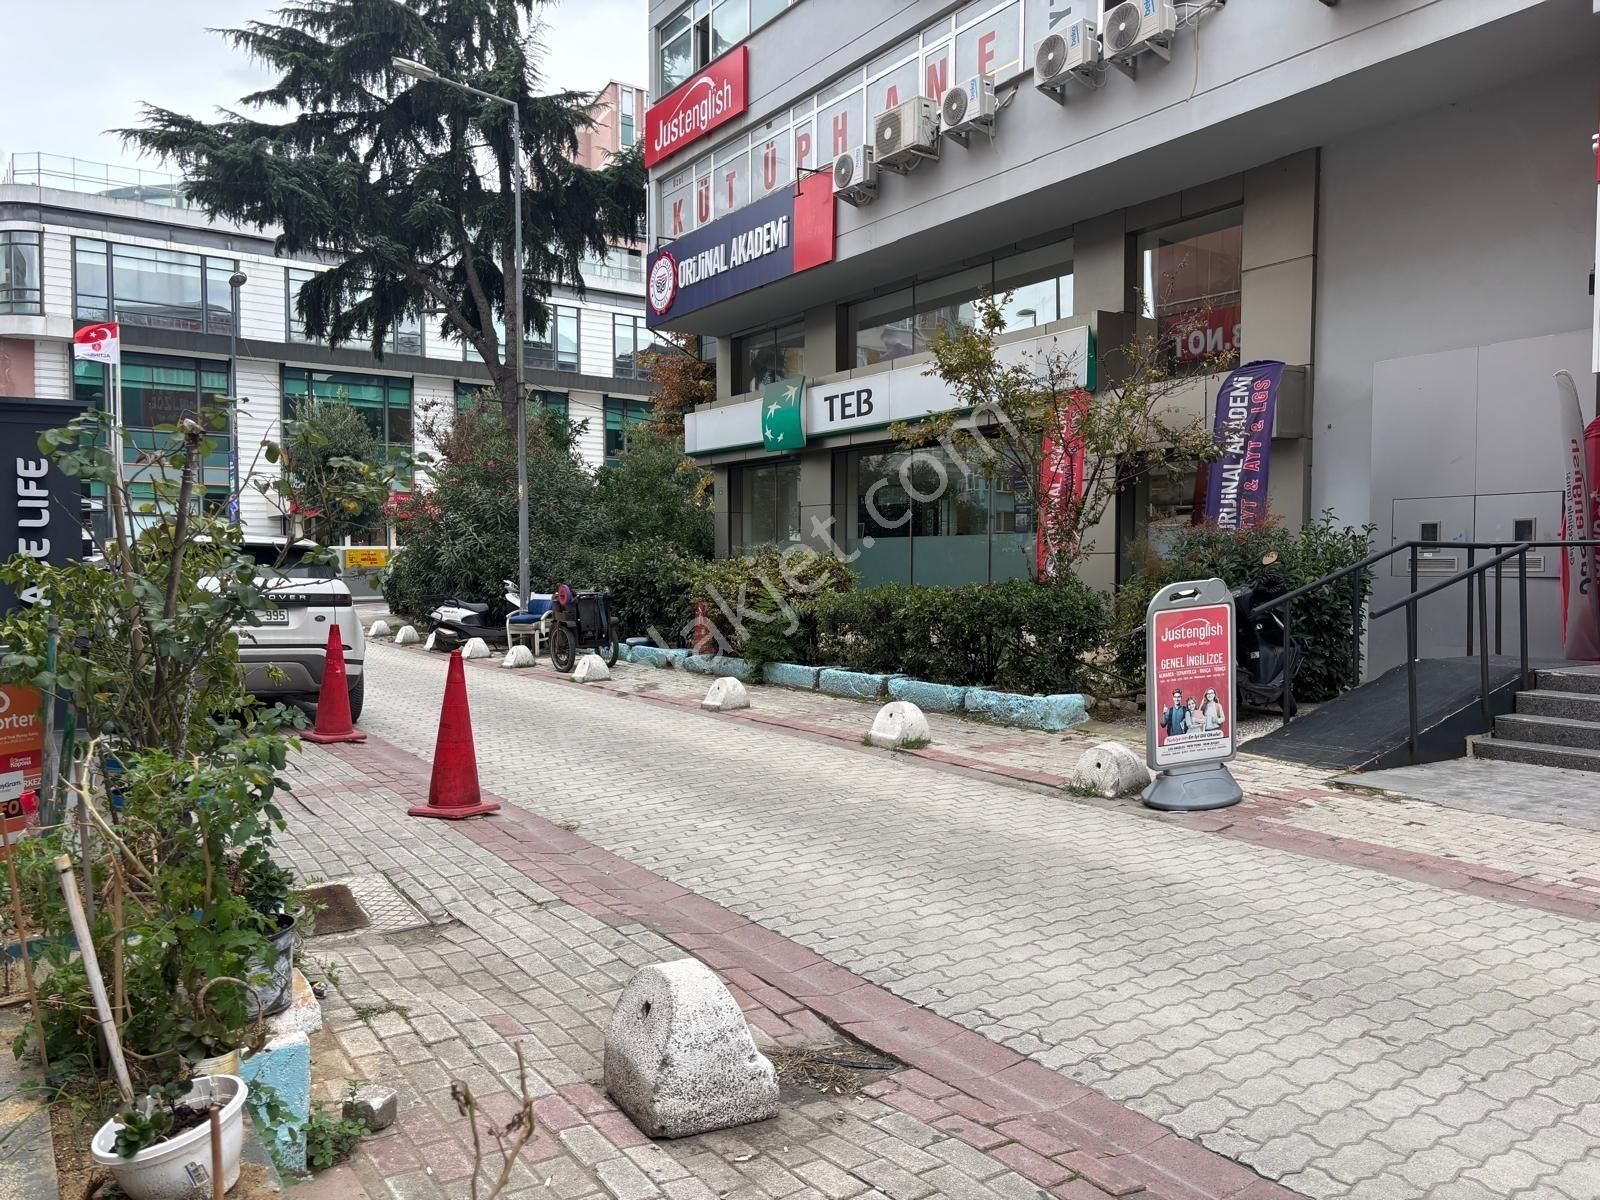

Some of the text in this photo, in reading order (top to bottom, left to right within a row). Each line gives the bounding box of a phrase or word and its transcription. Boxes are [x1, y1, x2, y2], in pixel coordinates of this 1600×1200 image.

[654, 79, 732, 152] Justenglish
[823, 388, 874, 422] TEB
[1251, 379, 1272, 414] LGS
[1251, 419, 1265, 432] &
[1243, 440, 1263, 472] AYT
[16, 457, 50, 527] LIFE
[1244, 479, 1259, 492] &
[265, 611, 286, 621] 995
[1160, 623, 1223, 643] Justenglish
[1160, 652, 1224, 670] GENEL İNGİLİZCE
